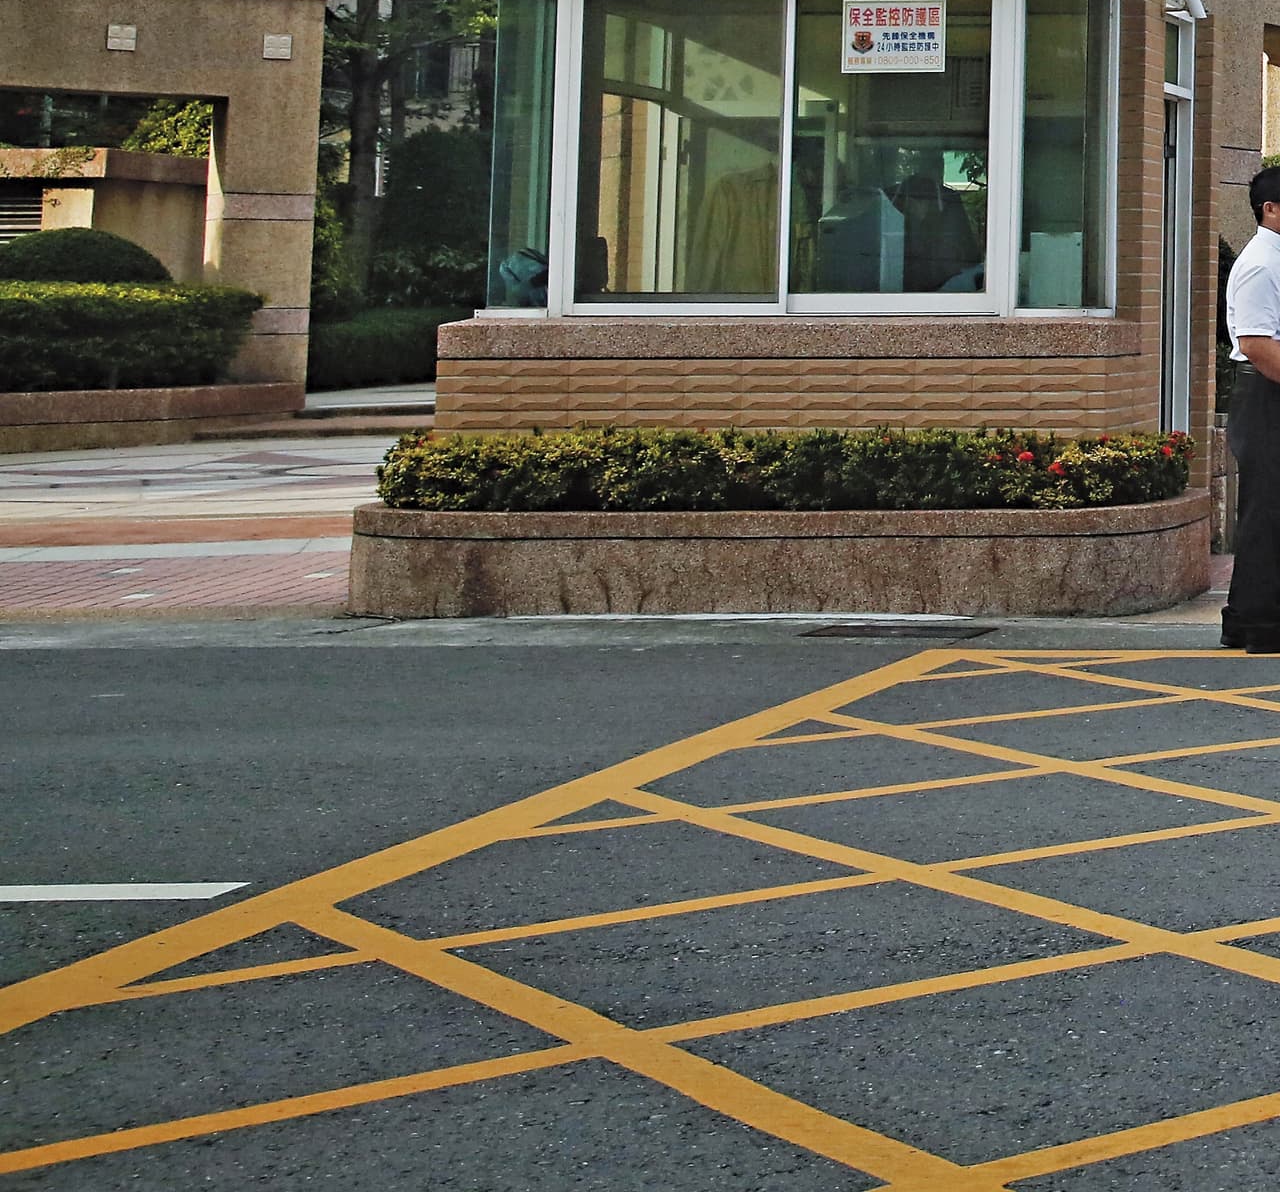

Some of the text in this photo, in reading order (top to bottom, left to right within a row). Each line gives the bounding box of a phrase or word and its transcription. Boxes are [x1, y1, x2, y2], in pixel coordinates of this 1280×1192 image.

[849, 7, 941, 26] 保全監控防護區
